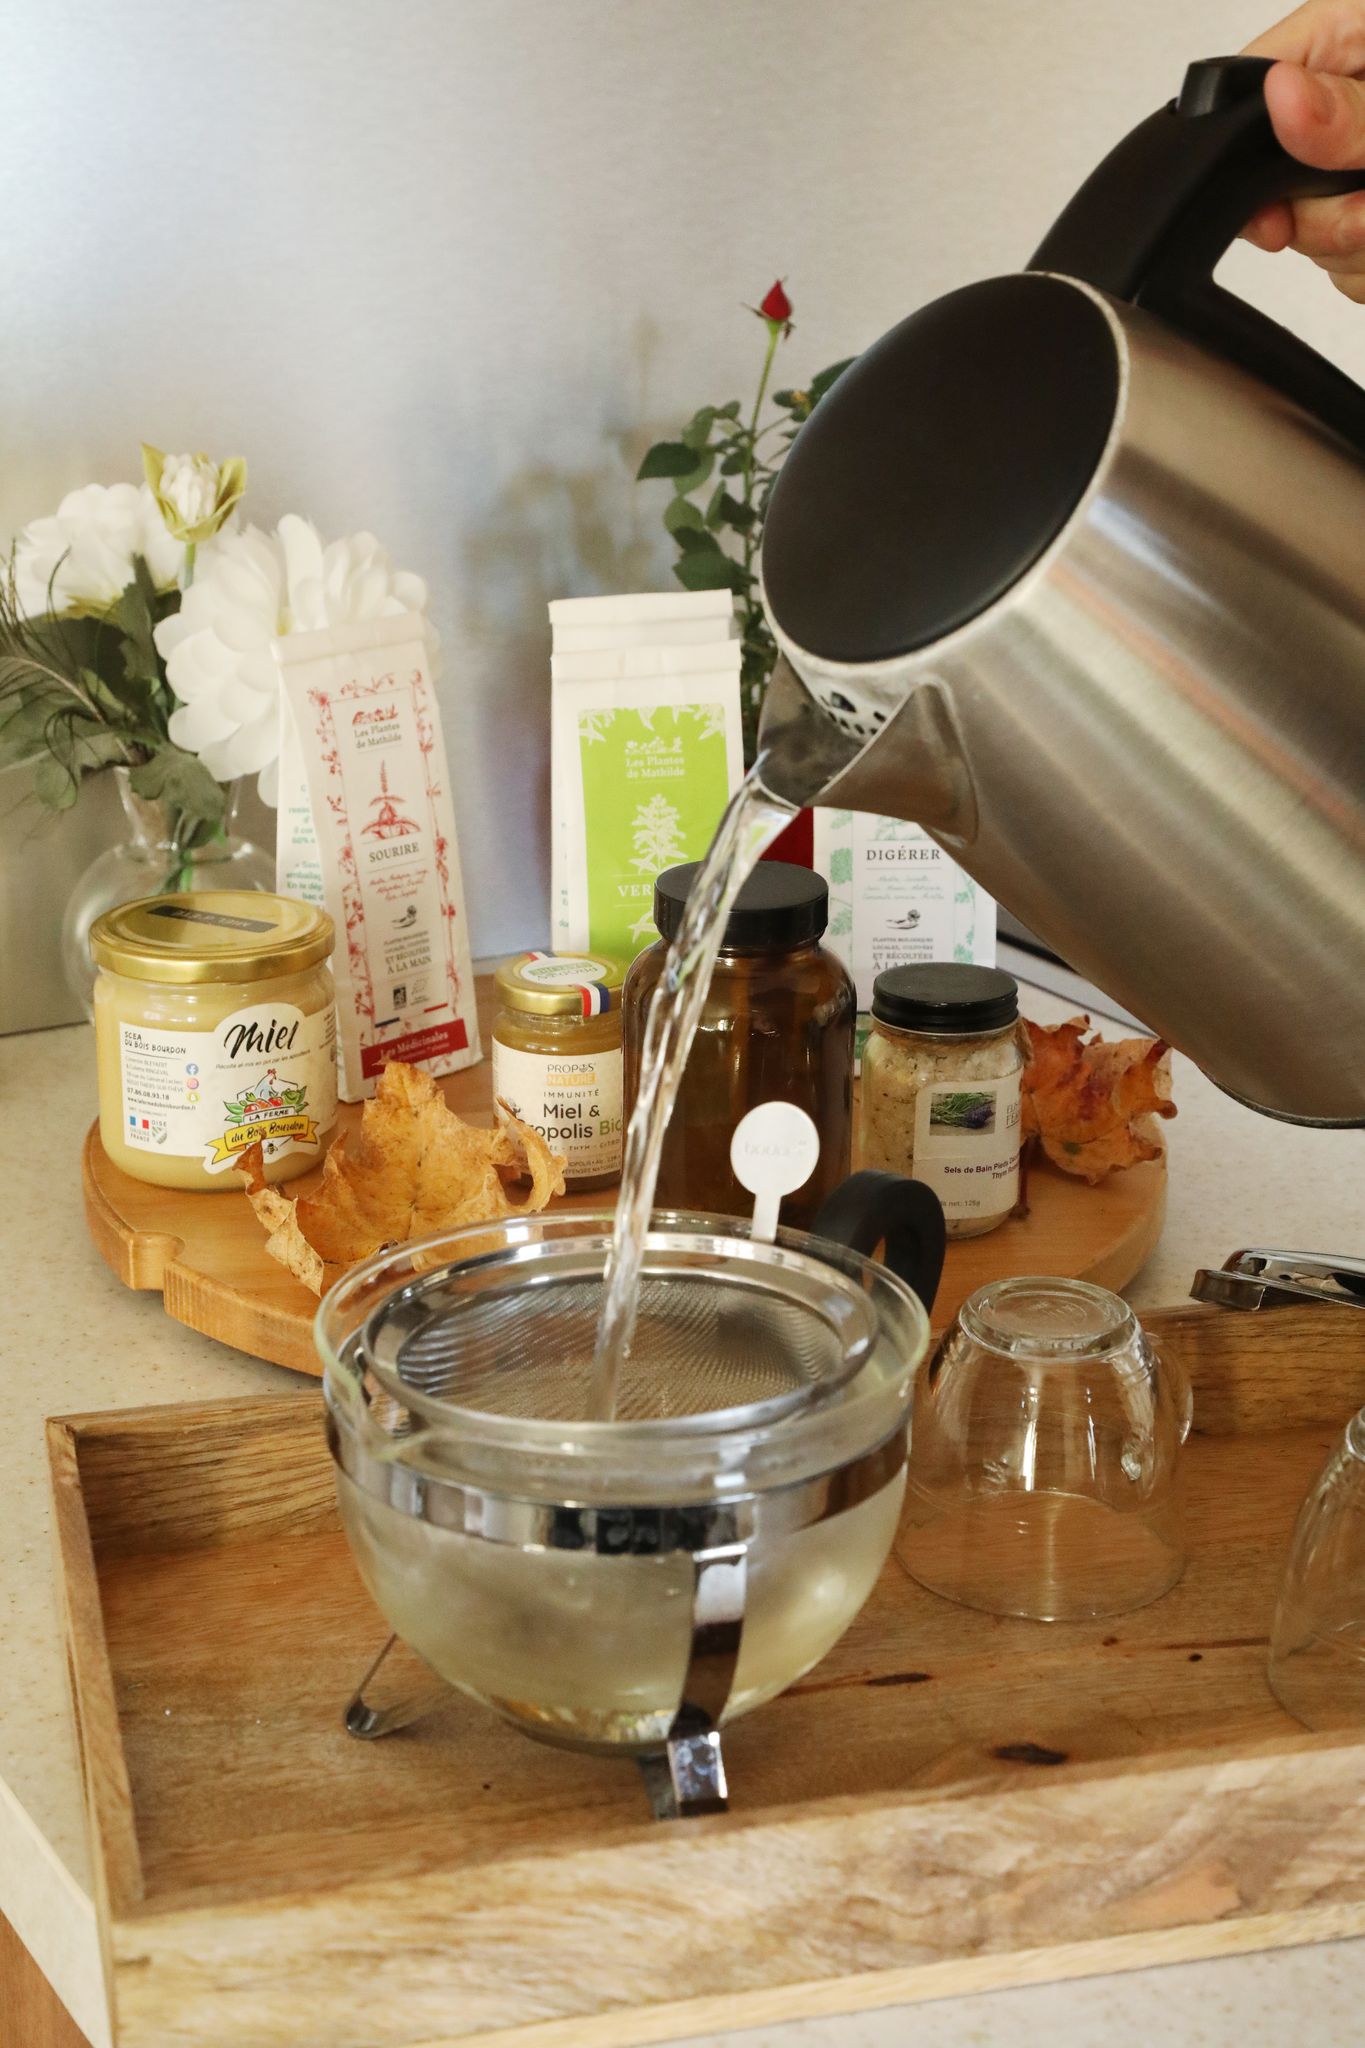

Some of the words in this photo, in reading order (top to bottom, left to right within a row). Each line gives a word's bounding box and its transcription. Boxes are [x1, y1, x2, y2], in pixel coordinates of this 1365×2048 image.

[369, 842, 419, 862] SOURIRE
[866, 845, 940, 861] DIGÉRER
[124, 1031, 142, 1041] SCEA
[223, 1018, 300, 1059] Miel
[134, 1041, 149, 1050] BOIS
[152, 1044, 186, 1054] BOURDON
[543, 1089, 600, 1099] IMMUNITÉ
[249, 1113, 260, 1122] LA
[264, 1109, 289, 1119] FERME
[543, 1103, 582, 1119] Miel
[589, 1105, 600, 1118] &
[231, 1130, 243, 1143] du
[269, 1121, 305, 1135] Bourdon
[530, 1123, 593, 1142] opolis
[944, 1166, 962, 1174] Sels
[963, 1166, 974, 1174] de
[975, 1164, 993, 1173] Bain
